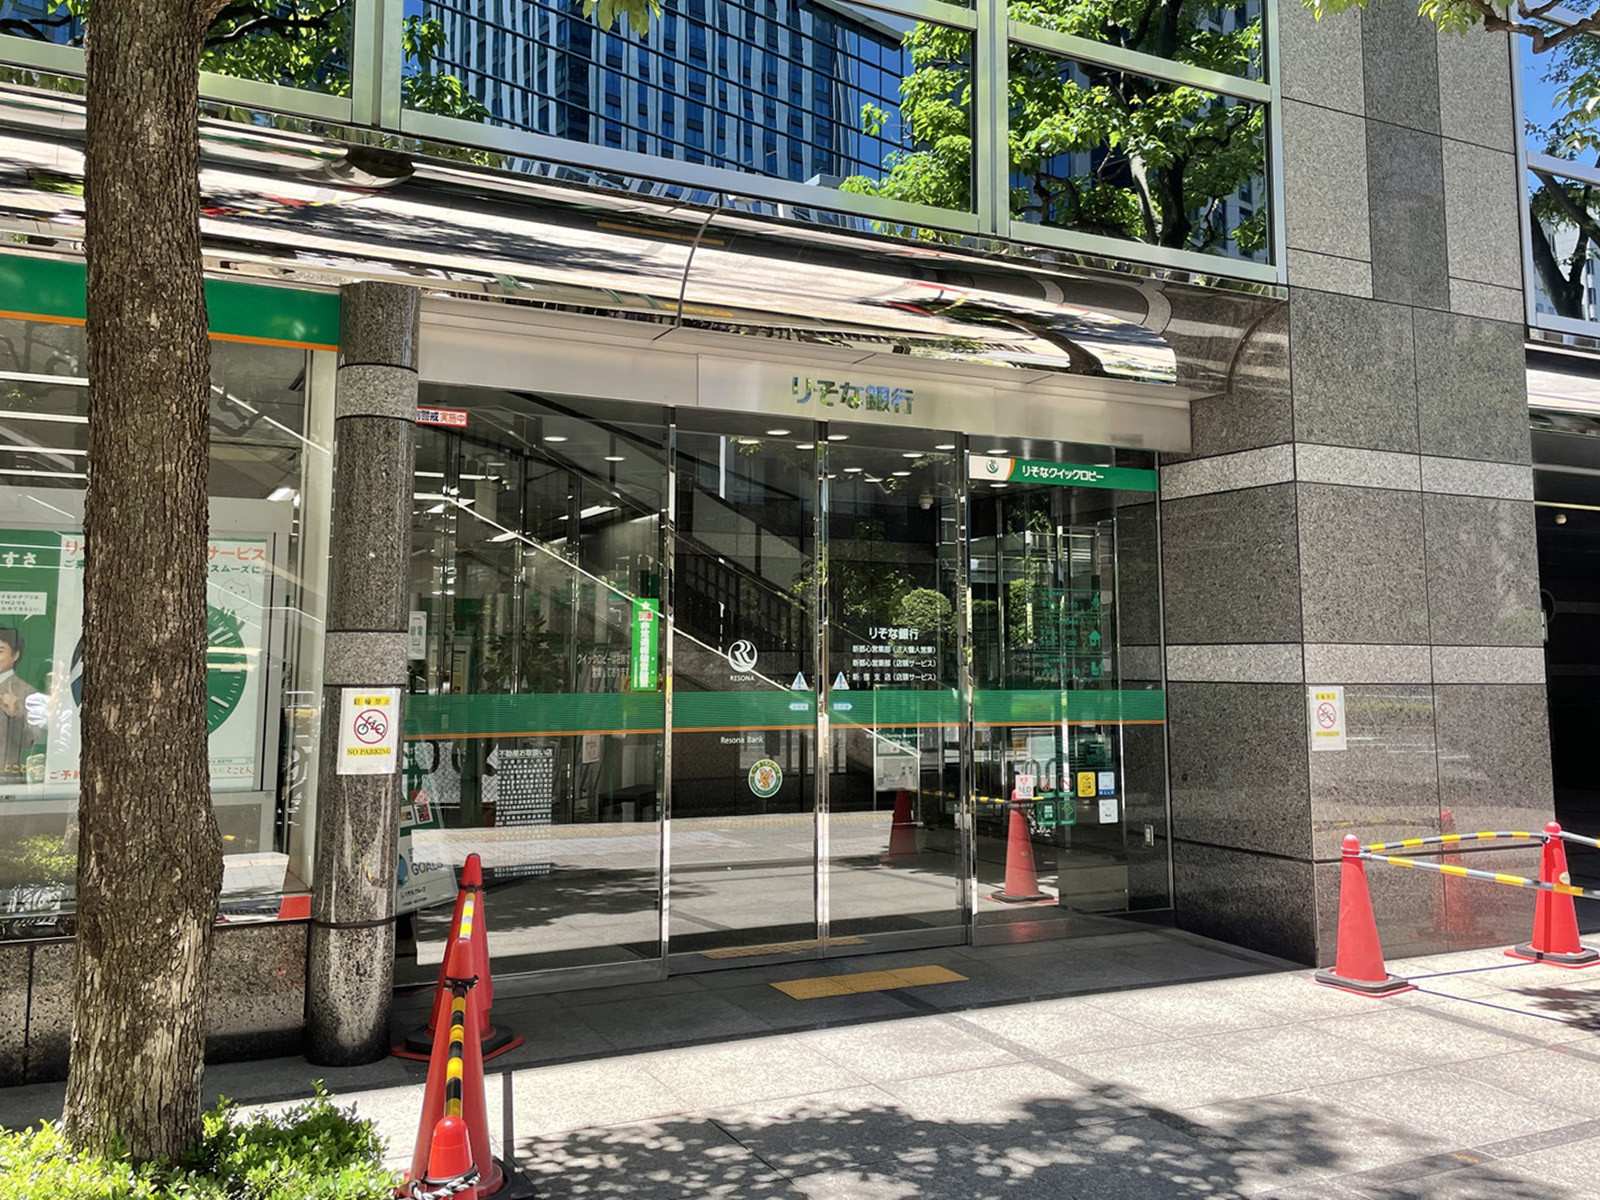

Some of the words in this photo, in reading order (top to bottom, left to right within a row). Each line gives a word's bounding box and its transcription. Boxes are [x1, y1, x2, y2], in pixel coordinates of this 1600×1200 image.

[792, 376, 914, 415] りそな銀行
[1022, 465, 1104, 482] りそなクイックロビー
[64, 540, 85, 556] り
[208, 546, 265, 560] サービス
[2, 551, 36, 568] すさ
[211, 564, 260, 574] スムーズに
[869, 627, 920, 640] りそな銀行
[720, 736, 745, 744] Resona
[347, 748, 358, 756] NO
[360, 747, 391, 755] PARKING
